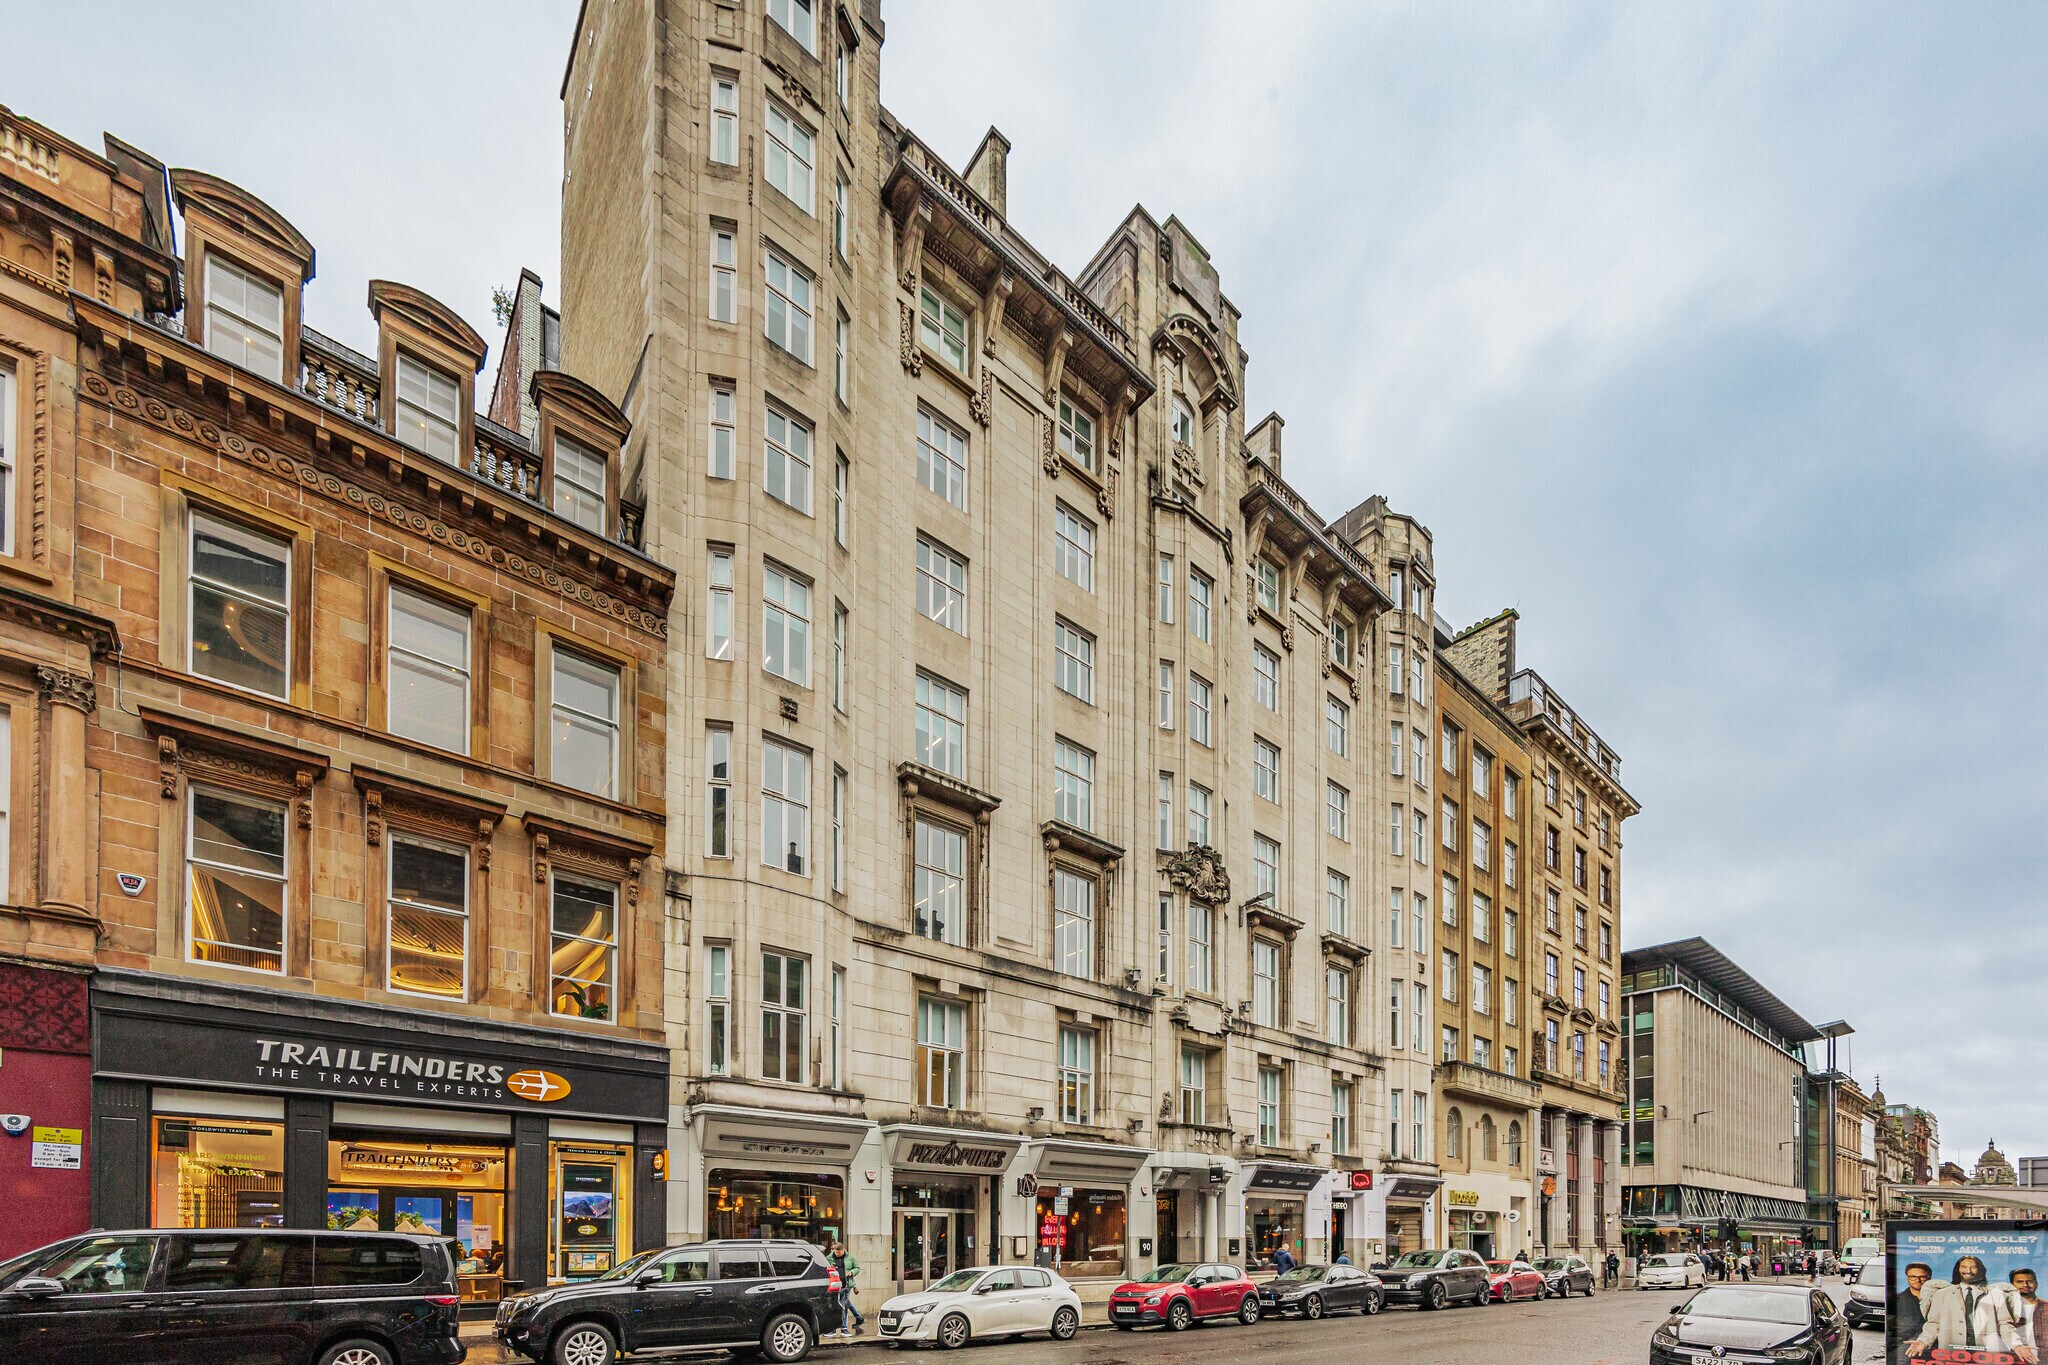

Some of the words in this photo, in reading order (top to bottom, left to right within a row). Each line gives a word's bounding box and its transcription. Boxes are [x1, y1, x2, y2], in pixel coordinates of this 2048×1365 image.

[256, 1039, 504, 1084] TRAILFINDERS
[256, 1066, 299, 1080] THE
[318, 1072, 400, 1089] TRAVEL
[417, 1081, 502, 1098] EXPERTS
[346, 1152, 453, 1167] TRAILFINDERS
[958, 1147, 1007, 1168] PUNKS
[1334, 1202, 1348, 1210] HIPPO
[1142, 1242, 1151, 1251] 90
[1931, 1349, 2014, 1364] GOOD
